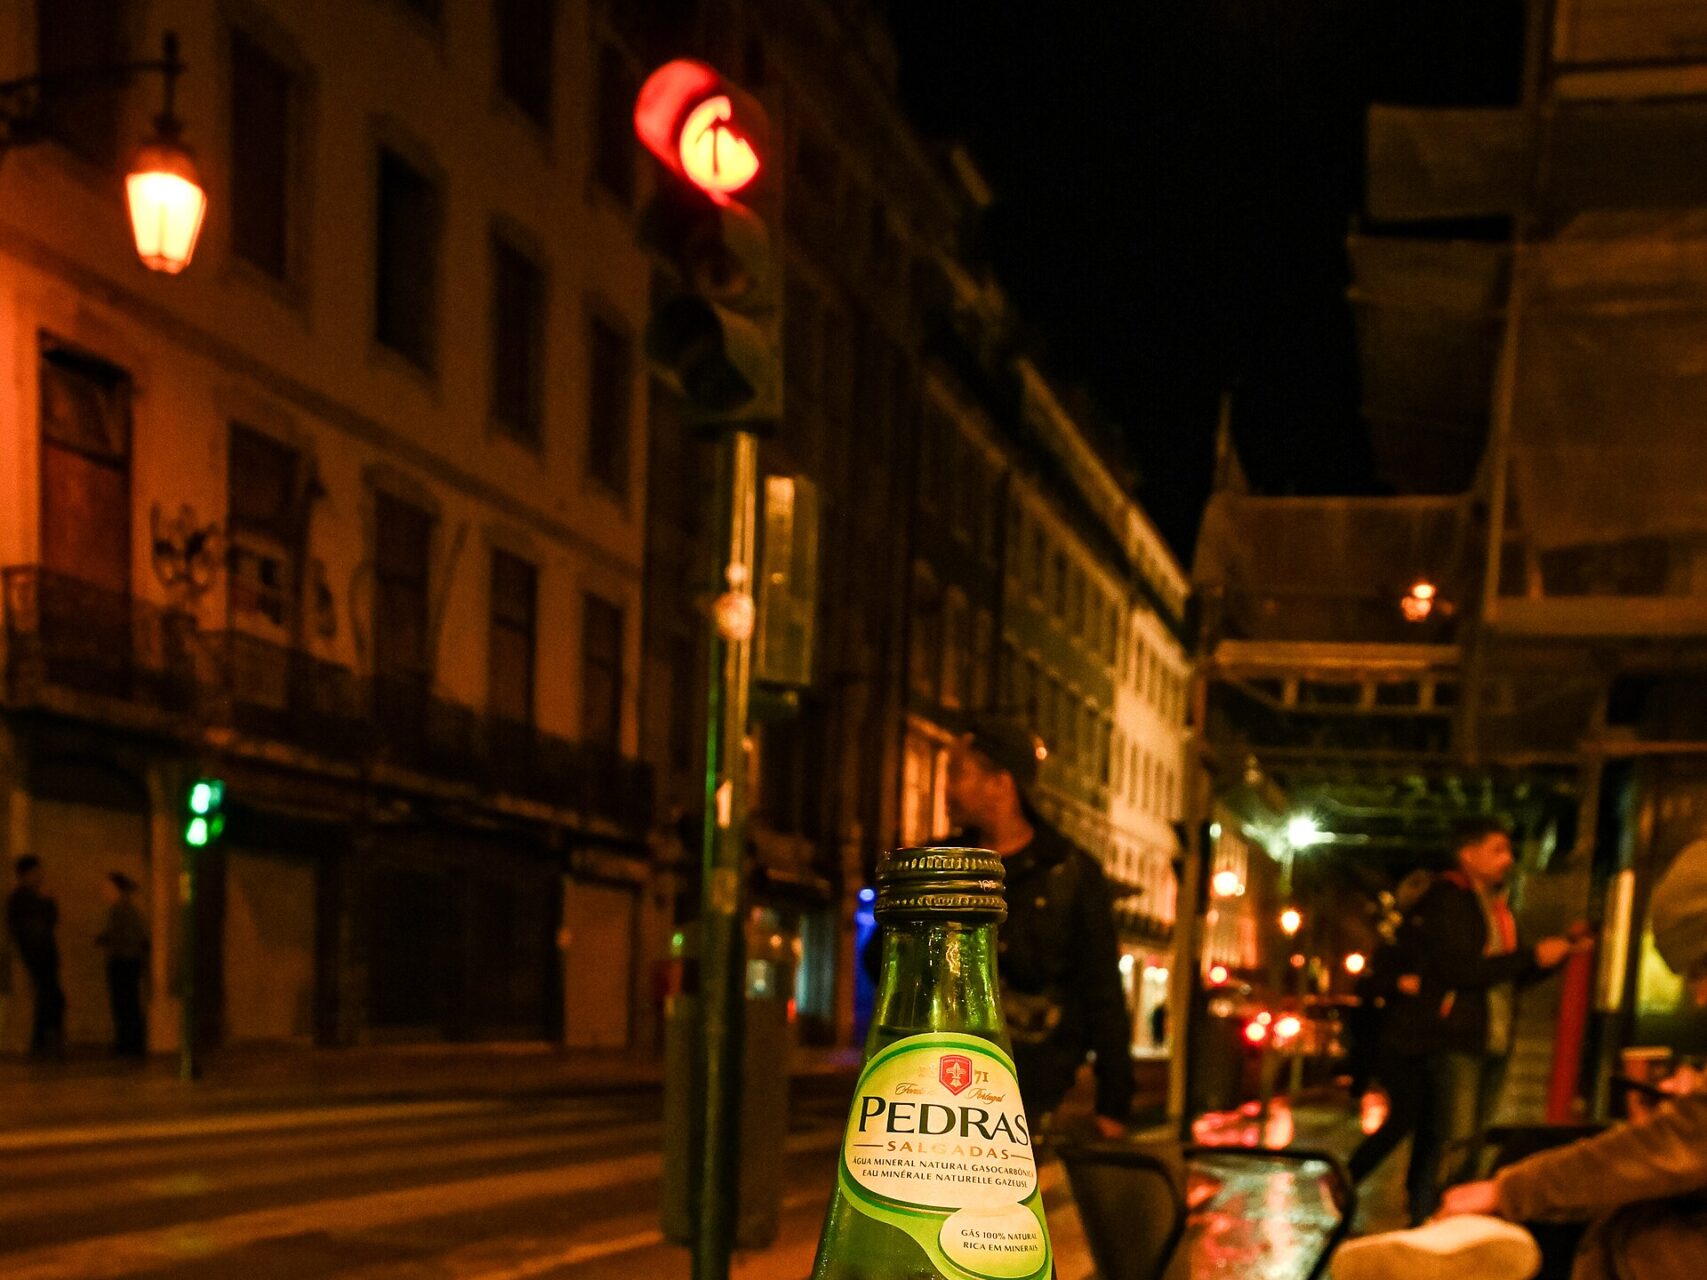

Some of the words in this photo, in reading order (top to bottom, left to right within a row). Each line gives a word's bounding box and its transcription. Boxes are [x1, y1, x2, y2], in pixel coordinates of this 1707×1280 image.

[859, 1096, 1030, 1146] PEDRAS
[887, 1140, 1009, 1160] SALGADAS
[852, 1155, 872, 1166] ÁGUA
[873, 1158, 916, 1168] MINERAL
[919, 1161, 968, 1171] NATURAL
[862, 1169, 879, 1178] EAU
[880, 1169, 932, 1181] MINÉRALE
[935, 1174, 993, 1185] NATURELLE
[994, 1178, 1028, 1189] GAZEUSE
[983, 1231, 1006, 1240] 100%
[963, 1241, 986, 1250] RICA
[988, 1244, 1002, 1252] EM
[1004, 1244, 1038, 1252] MINERAIS
